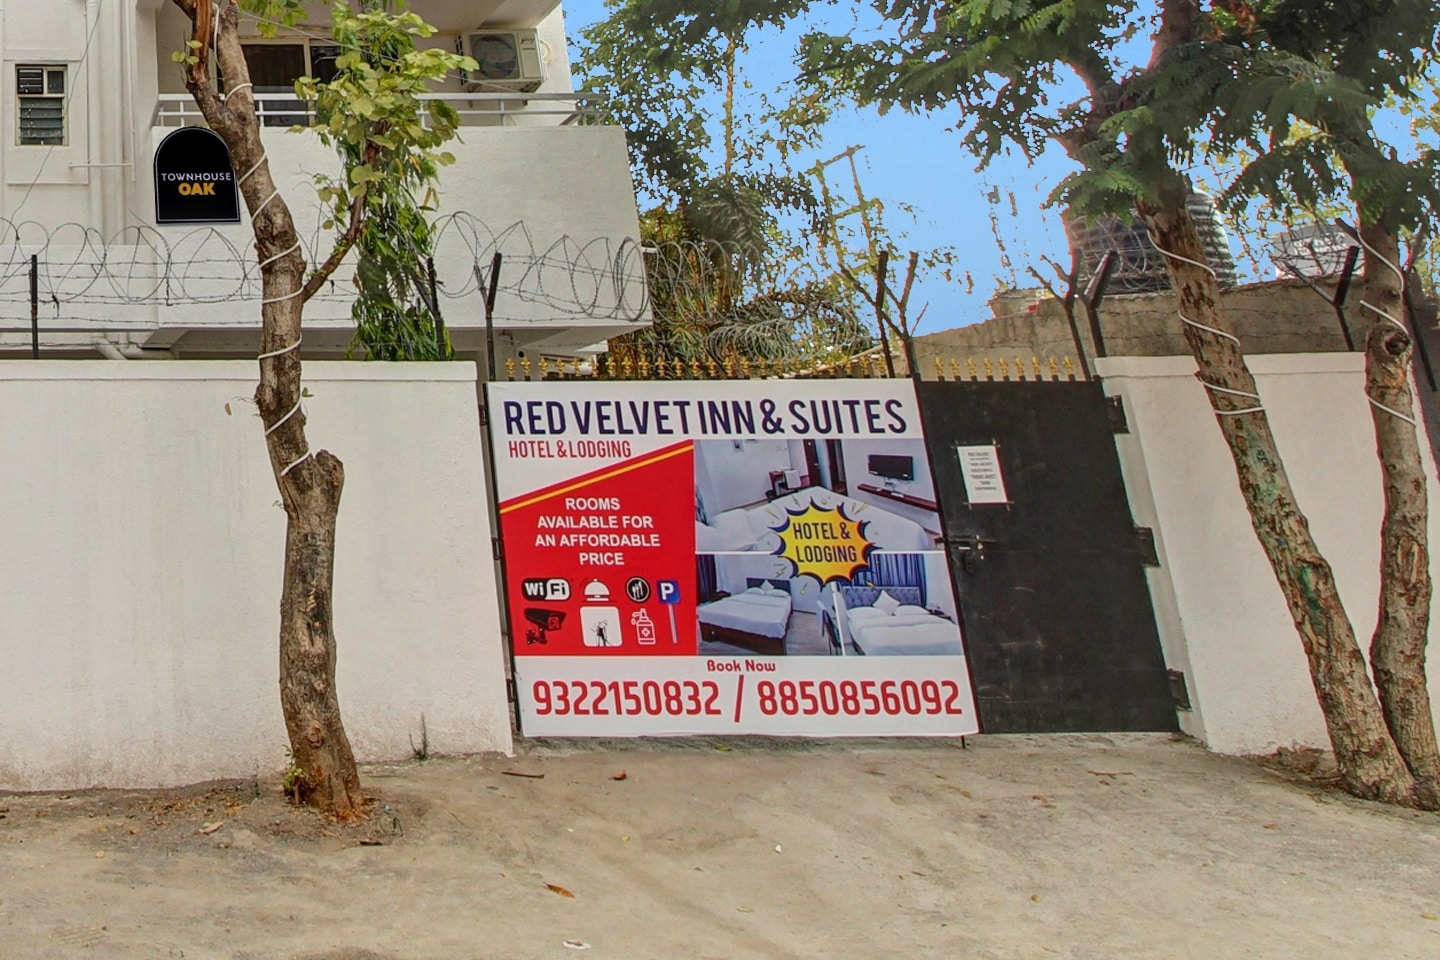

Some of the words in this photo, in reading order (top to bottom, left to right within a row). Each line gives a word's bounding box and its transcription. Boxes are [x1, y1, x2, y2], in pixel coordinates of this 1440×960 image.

[161, 172, 232, 182] TOWNHOUSE
[178, 182, 216, 196] OAK
[504, 400, 567, 436] RED
[570, 400, 691, 435] VELVET
[698, 400, 755, 435] INN
[760, 398, 785, 434] &
[789, 399, 907, 433] SUITES
[508, 440, 556, 459] HOTEL
[557, 440, 568, 458] &
[570, 440, 632, 459] LODGING
[565, 497, 621, 512] ROOMS
[537, 516, 618, 529] AVAILABLE
[621, 515, 654, 529] FOR
[793, 522, 839, 540] HOTEL
[839, 522, 851, 539] &
[535, 534, 556, 548] AN
[559, 534, 661, 548] AFFORDABLE
[579, 552, 625, 566] PRICE
[796, 546, 858, 564] LODGING
[659, 582, 675, 601] P
[707, 659, 741, 673] Book
[745, 659, 776, 673] Now
[533, 680, 722, 717] 9322150832
[734, 674, 744, 723] /
[759, 680, 963, 716] 8850856092
